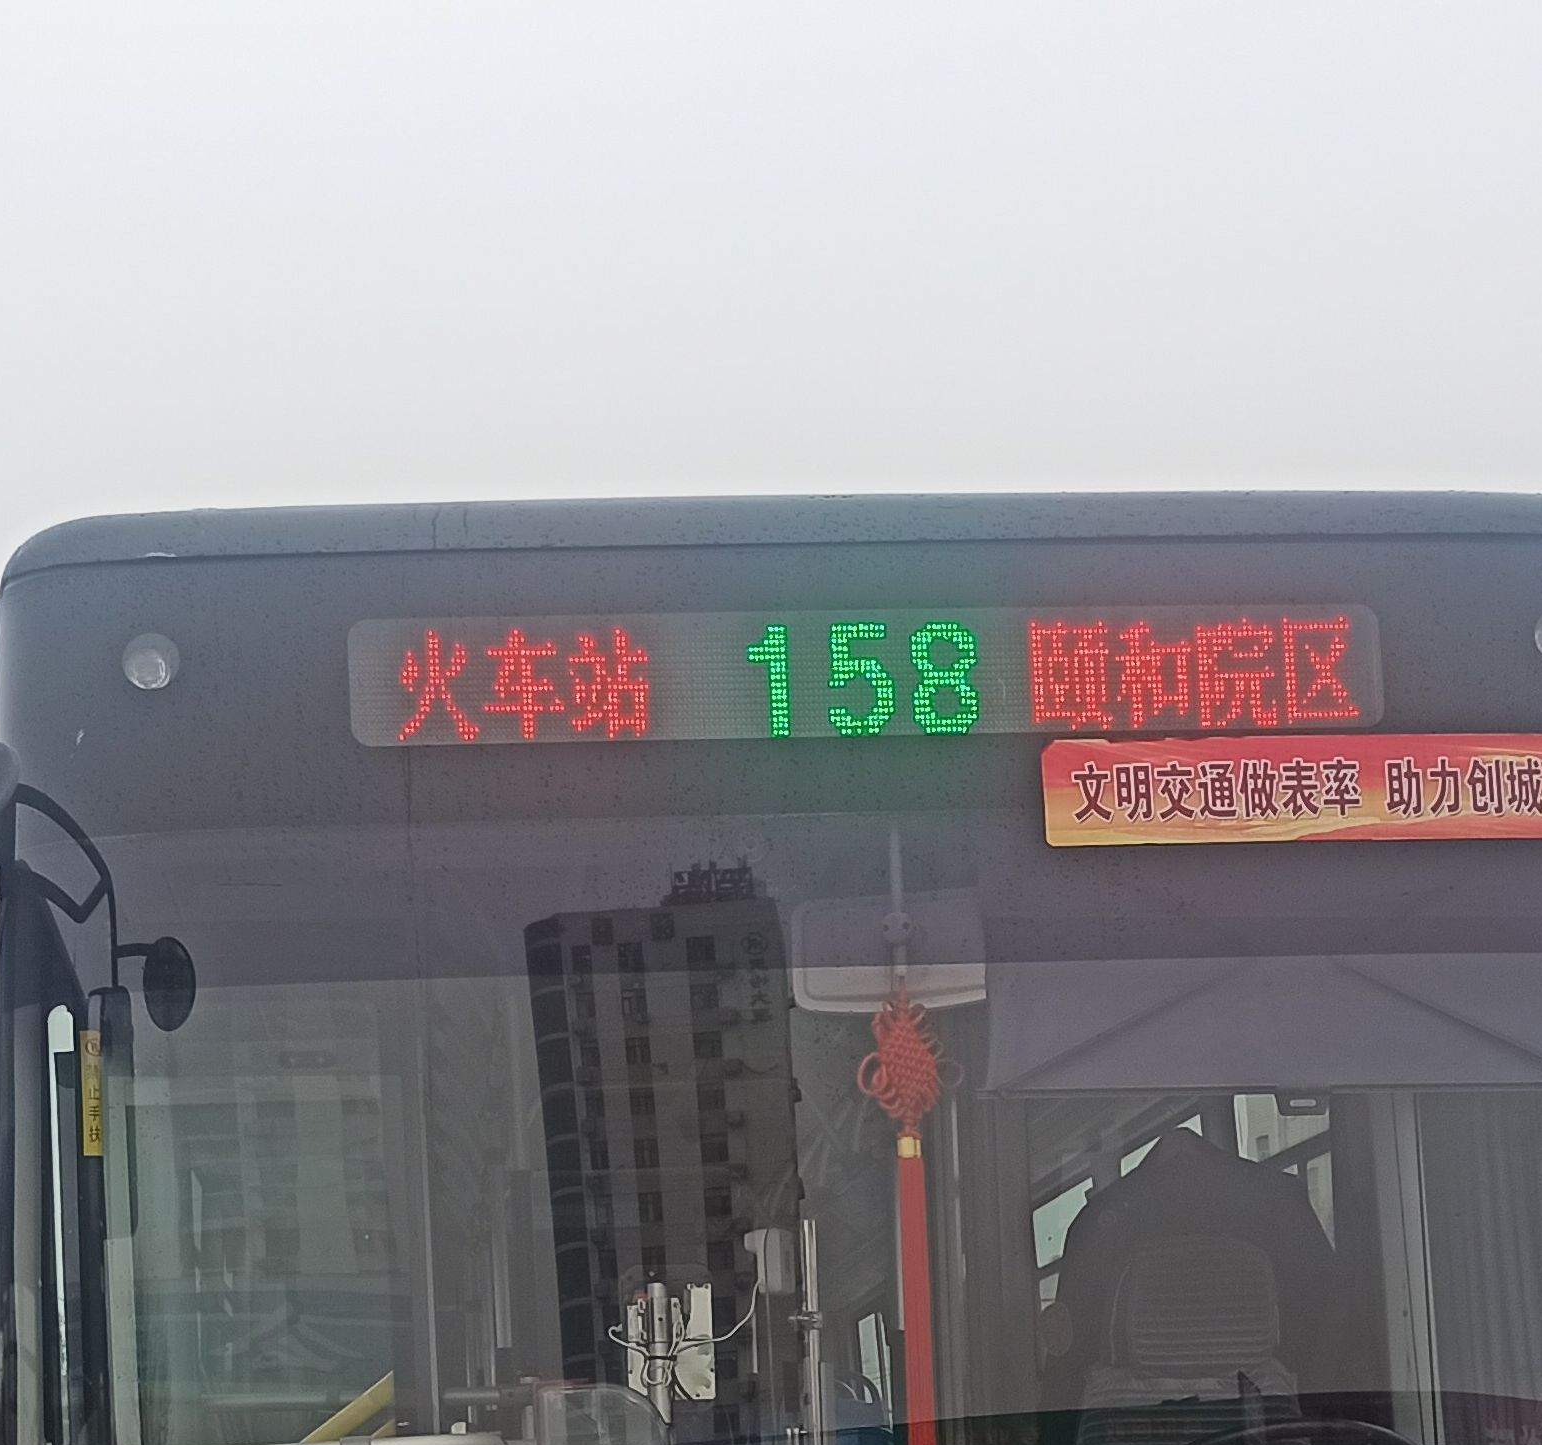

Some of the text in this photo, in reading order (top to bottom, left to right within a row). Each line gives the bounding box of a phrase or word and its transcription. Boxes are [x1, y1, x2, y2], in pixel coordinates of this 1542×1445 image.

[399, 615, 1360, 740] 火车站 158 颐和院区
[1071, 758, 1362, 823] 文明交通做表率
